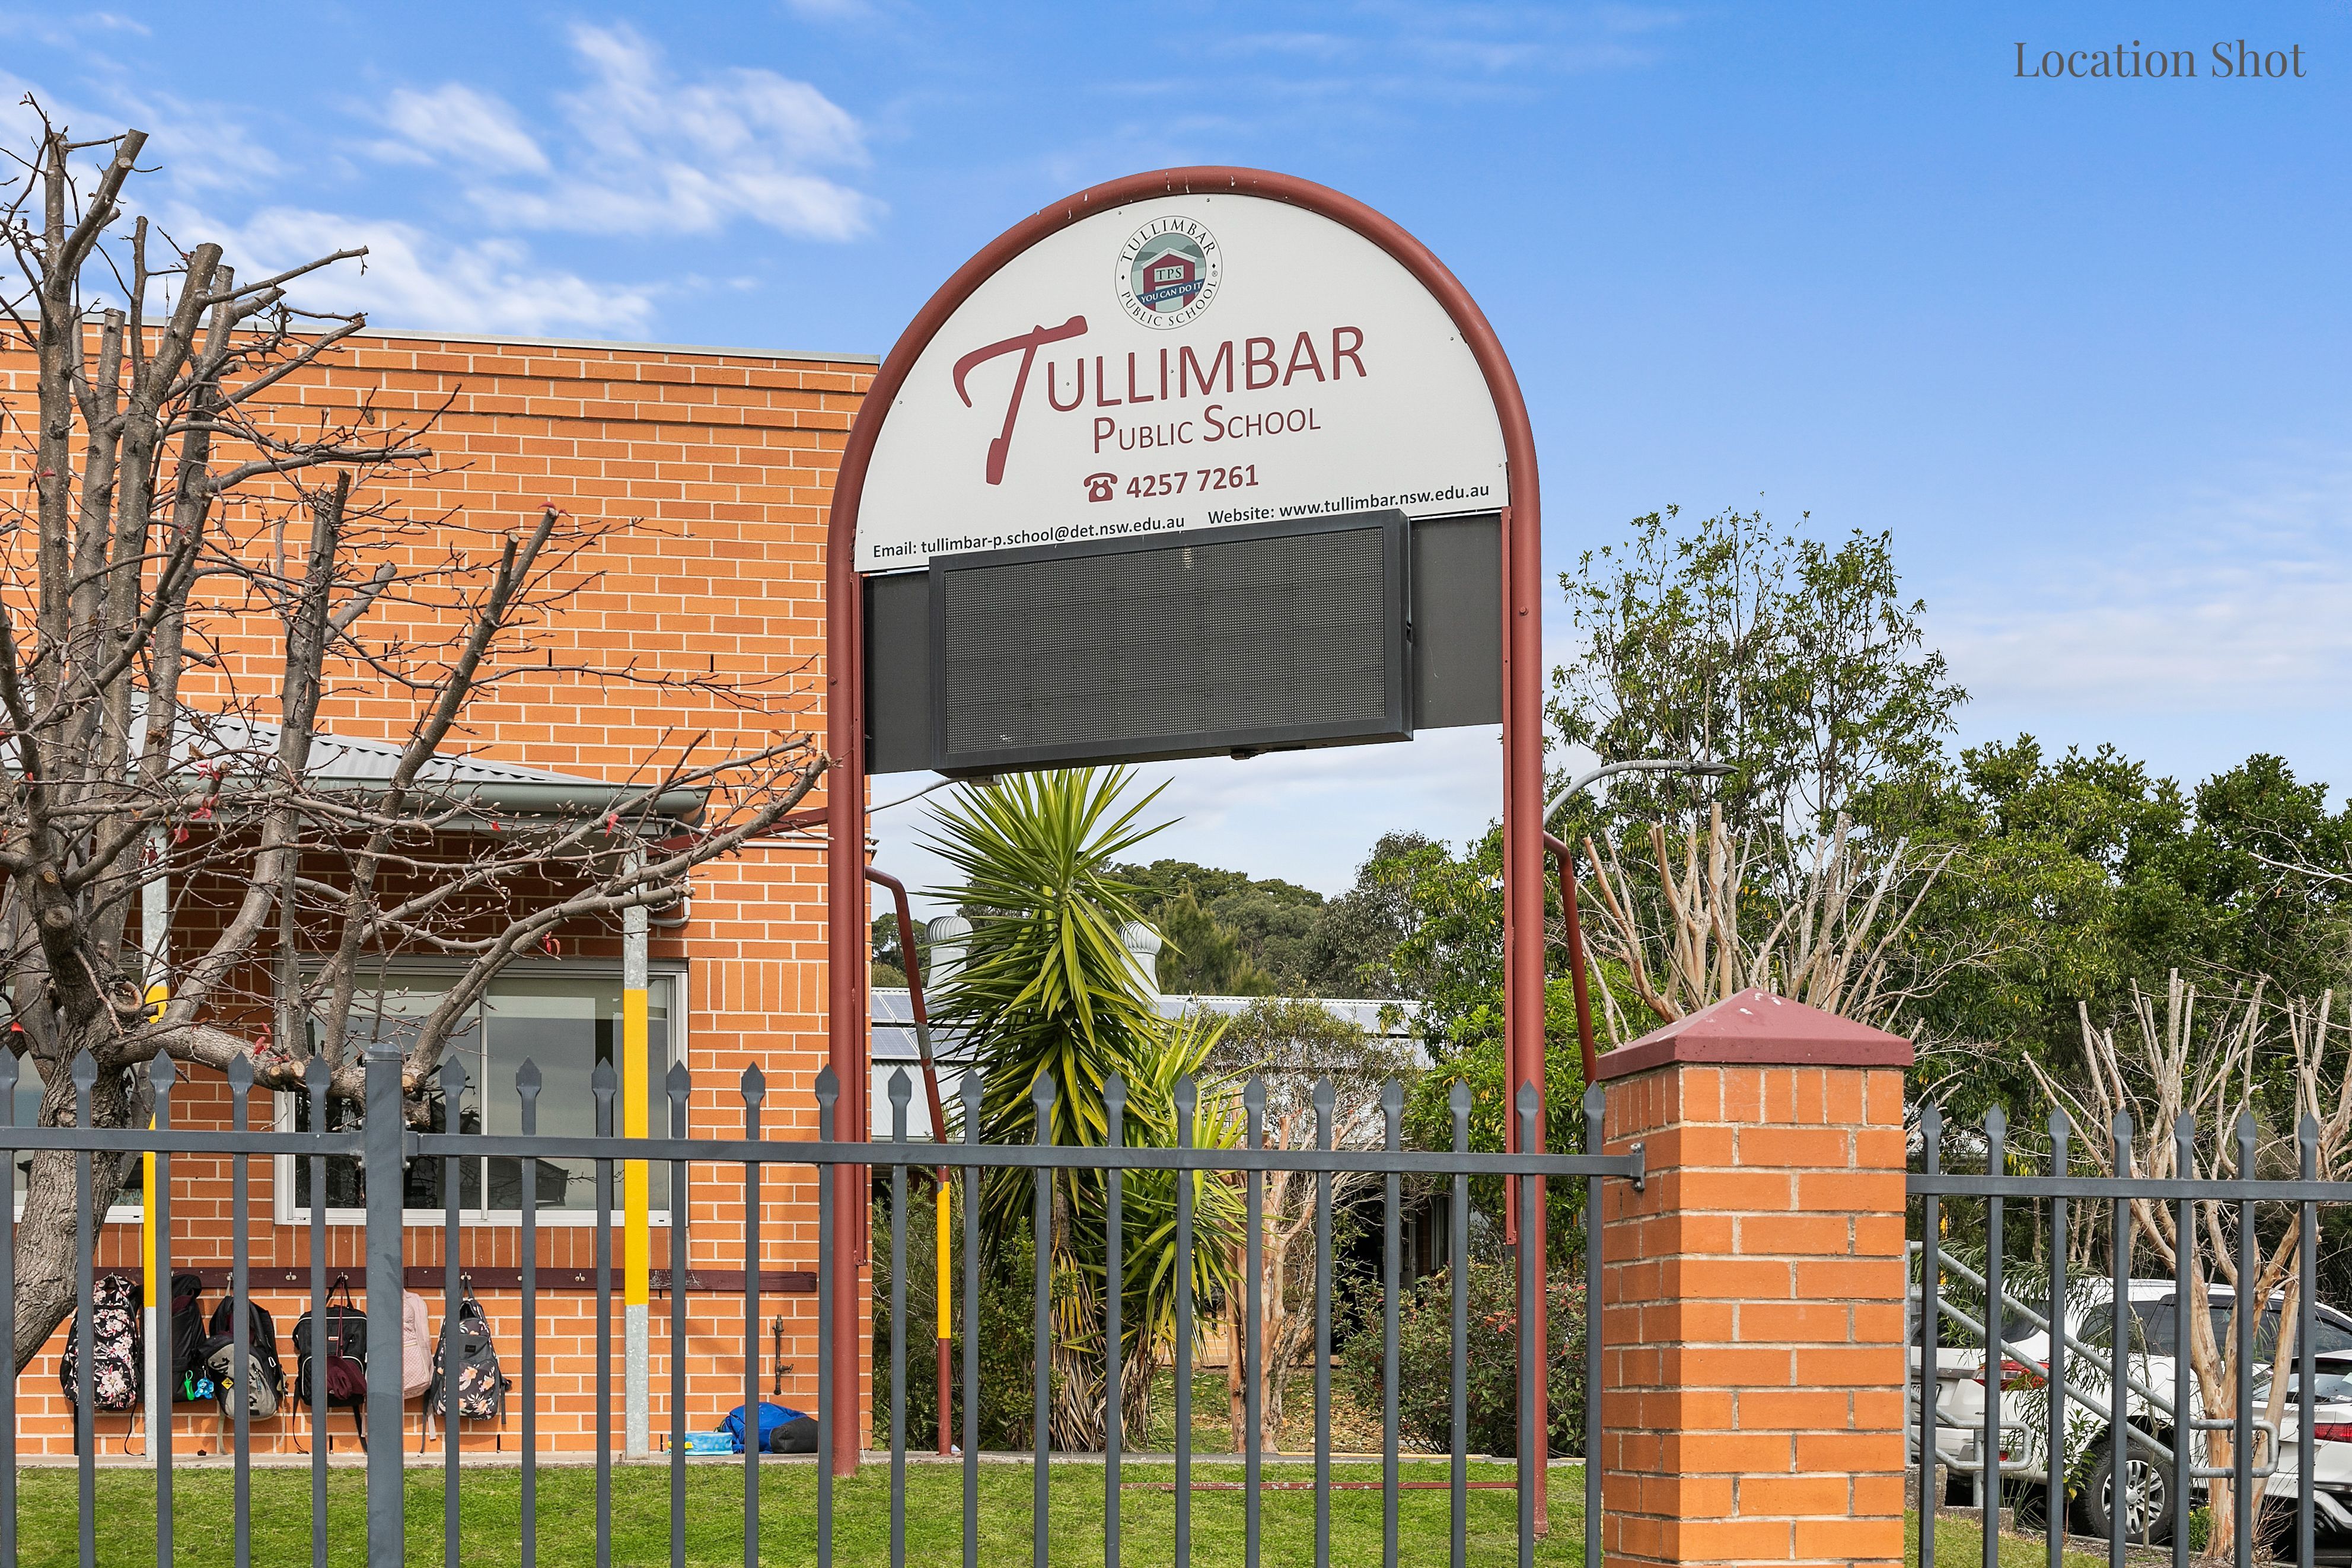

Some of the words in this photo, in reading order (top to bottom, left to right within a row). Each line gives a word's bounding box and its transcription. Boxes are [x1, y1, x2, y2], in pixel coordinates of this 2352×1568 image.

[1120, 218, 1216, 263] TULLIMBAR
[1140, 292, 1158, 304] YOU
[1159, 288, 1177, 299] CAN
[1178, 283, 1191, 294] DO
[1193, 282, 1202, 291] IT
[1156, 267, 1182, 281] TPS
[1121, 291, 1162, 327] PUBLIC
[1168, 281, 1217, 327] SCHOOL
[952, 314, 1367, 486] TULLIMBAR
[1092, 417, 1193, 454] PUBLIC
[1203, 404, 1321, 443] SCHOOL
[1126, 471, 1188, 499] 4257
[1197, 464, 1259, 492] 7261
[1208, 507, 1276, 524] Website:
[1279, 483, 1490, 518] www.tullimbar.nsw.edu.au
[873, 541, 917, 558] Email:
[920, 515, 1185, 553] tullimbar-p.school@det.nsw.edu.au
